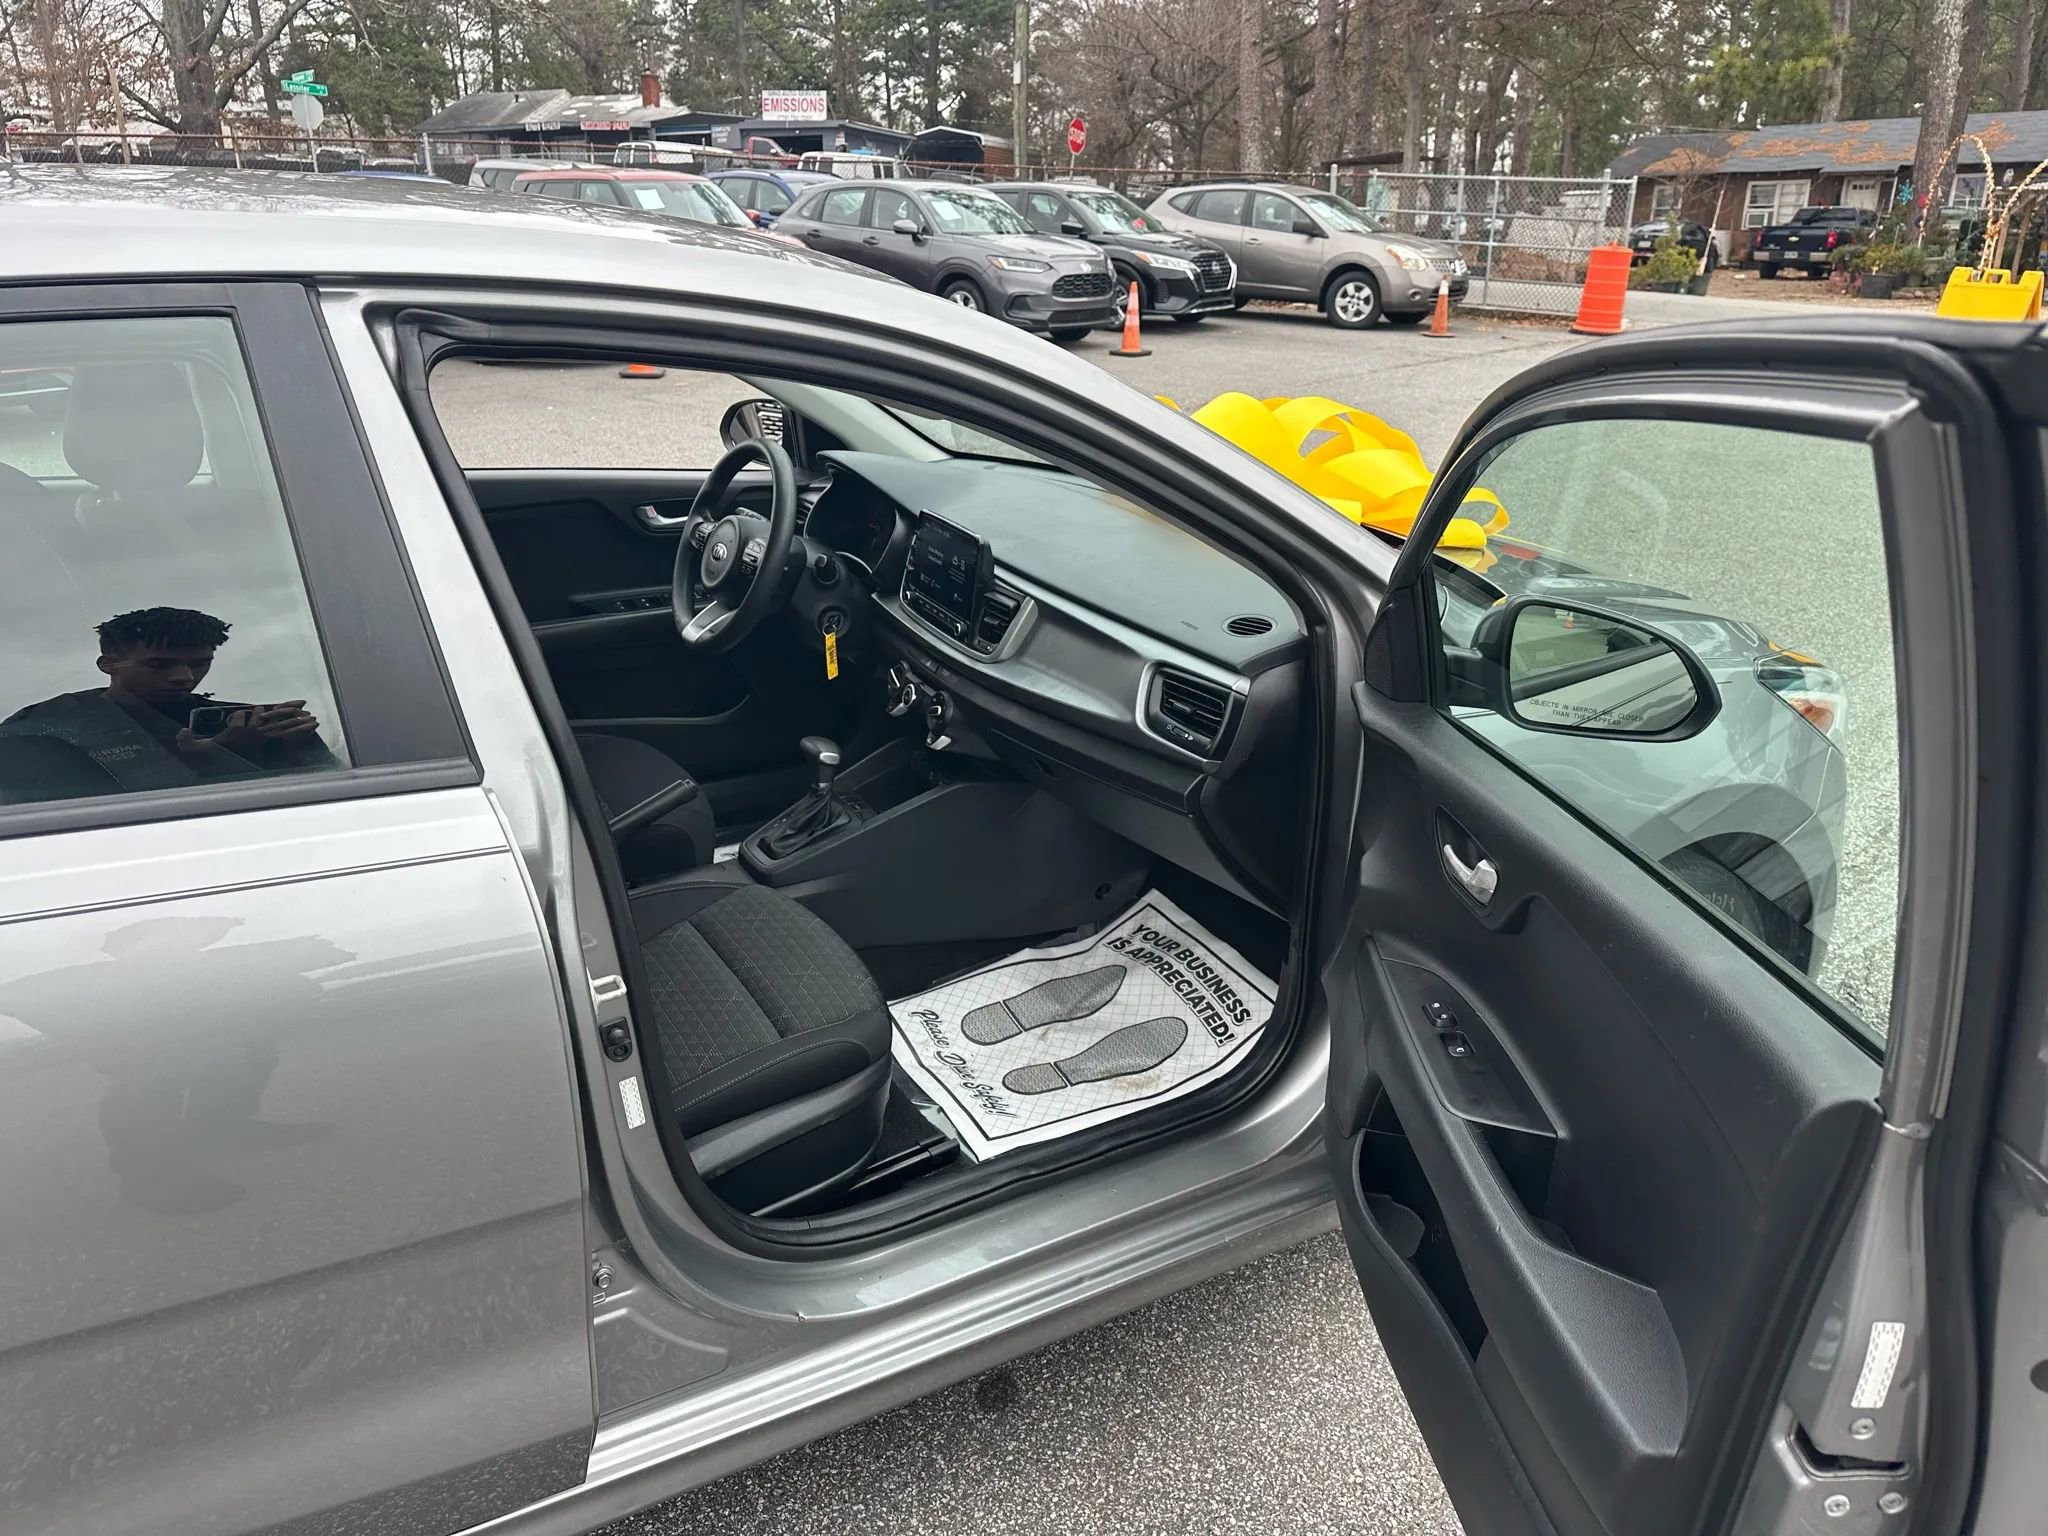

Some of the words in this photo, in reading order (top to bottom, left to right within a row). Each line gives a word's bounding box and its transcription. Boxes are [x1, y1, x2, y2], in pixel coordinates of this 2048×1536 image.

[763, 97, 825, 113] EMISSIONS
[1070, 127, 1085, 144] STOP
[1530, 699, 1559, 709] OBJECTS
[1572, 705, 1598, 714] MIRROR
[1617, 713, 1644, 722] CLOSER
[1552, 709, 1570, 718] THAN
[1131, 924, 1181, 953] YOUR
[1175, 948, 1251, 1024] BUSINESS
[1105, 936, 1133, 951] IS
[1124, 946, 1236, 1045] APPRECIATED!
[909, 1009, 949, 1048] Please
[934, 1050, 976, 1081] Drive
[961, 1082, 1018, 1117] Safely!
